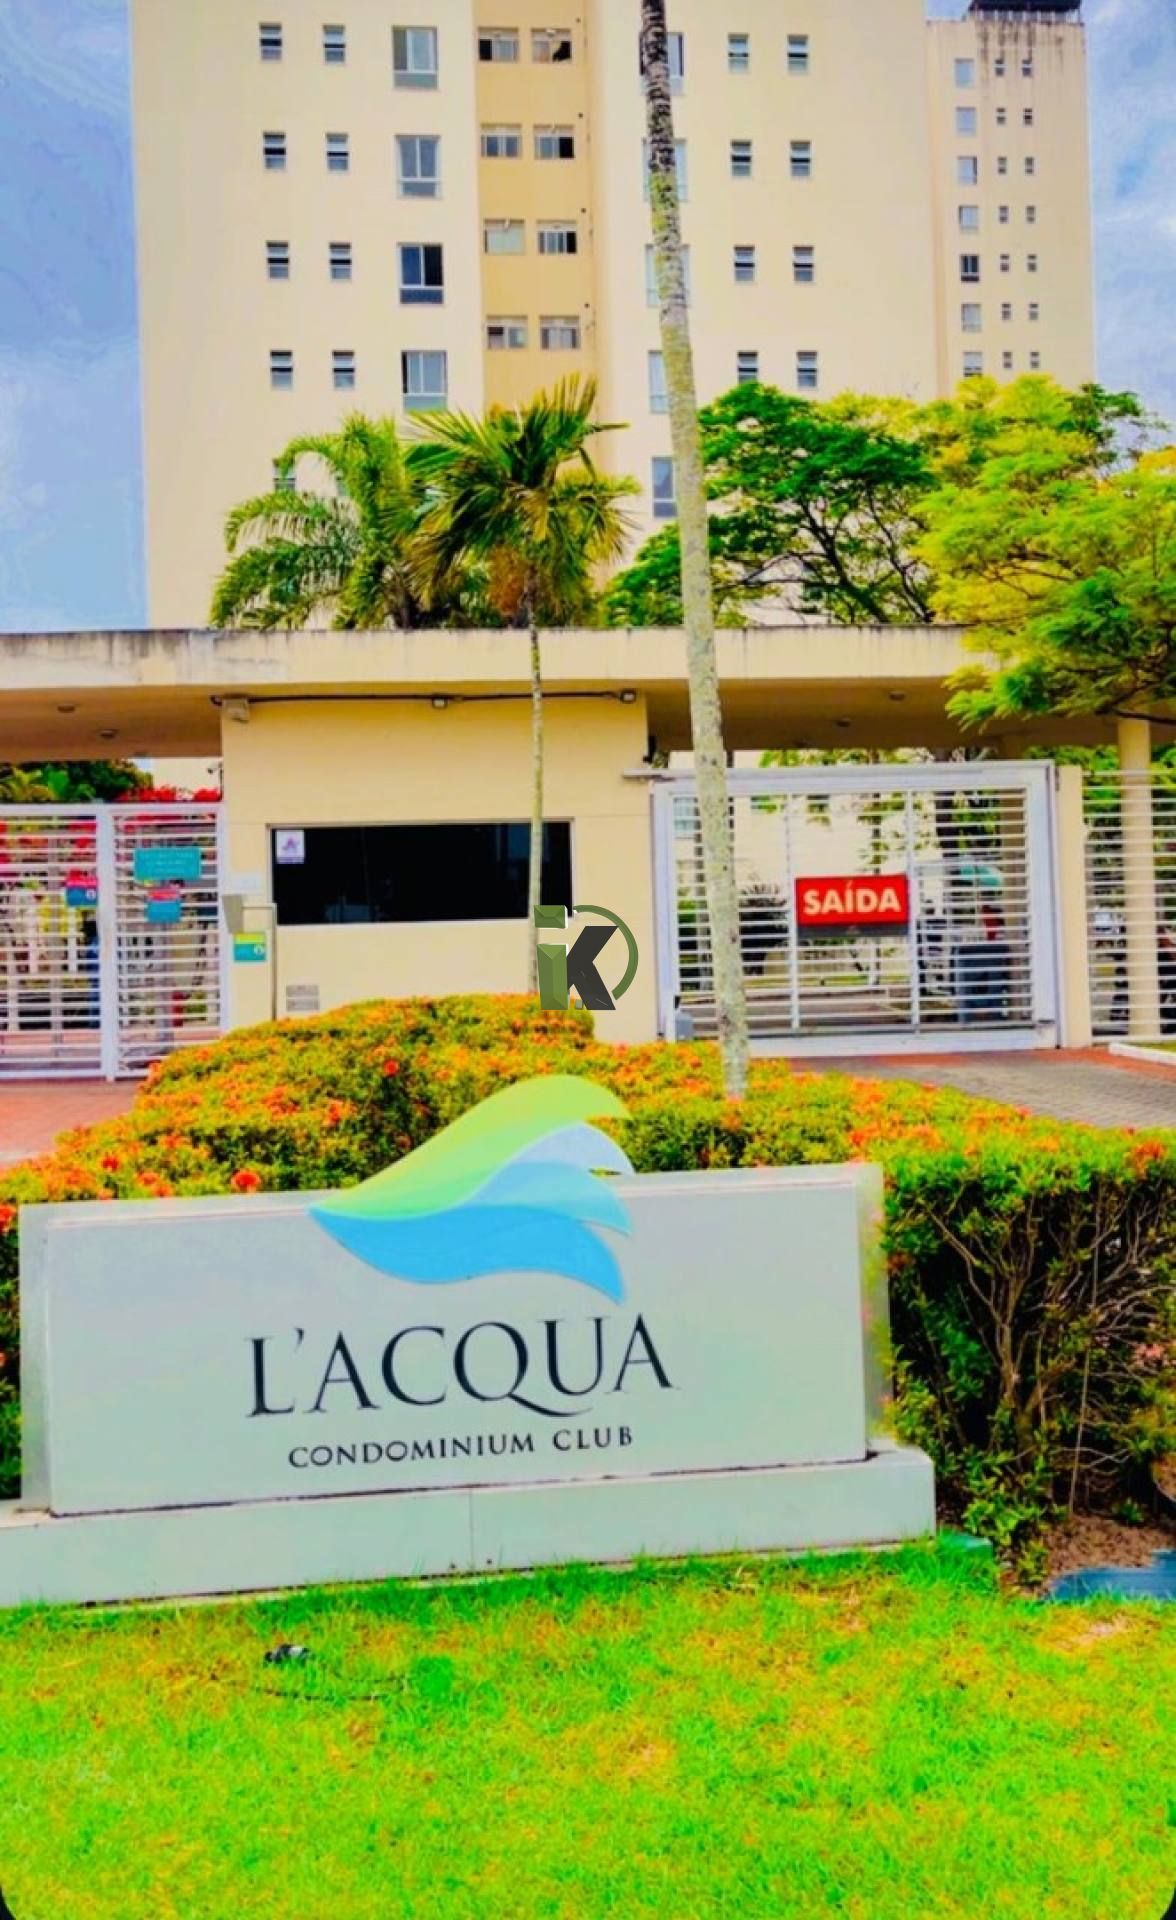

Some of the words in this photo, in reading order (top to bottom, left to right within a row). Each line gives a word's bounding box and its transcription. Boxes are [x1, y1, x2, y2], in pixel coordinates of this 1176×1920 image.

[803, 880, 901, 915] SAÍDA
[246, 1313, 677, 1417] L'ACQUA
[289, 1433, 535, 1468] CONDOMINIUM
[552, 1426, 633, 1451] CLUB
